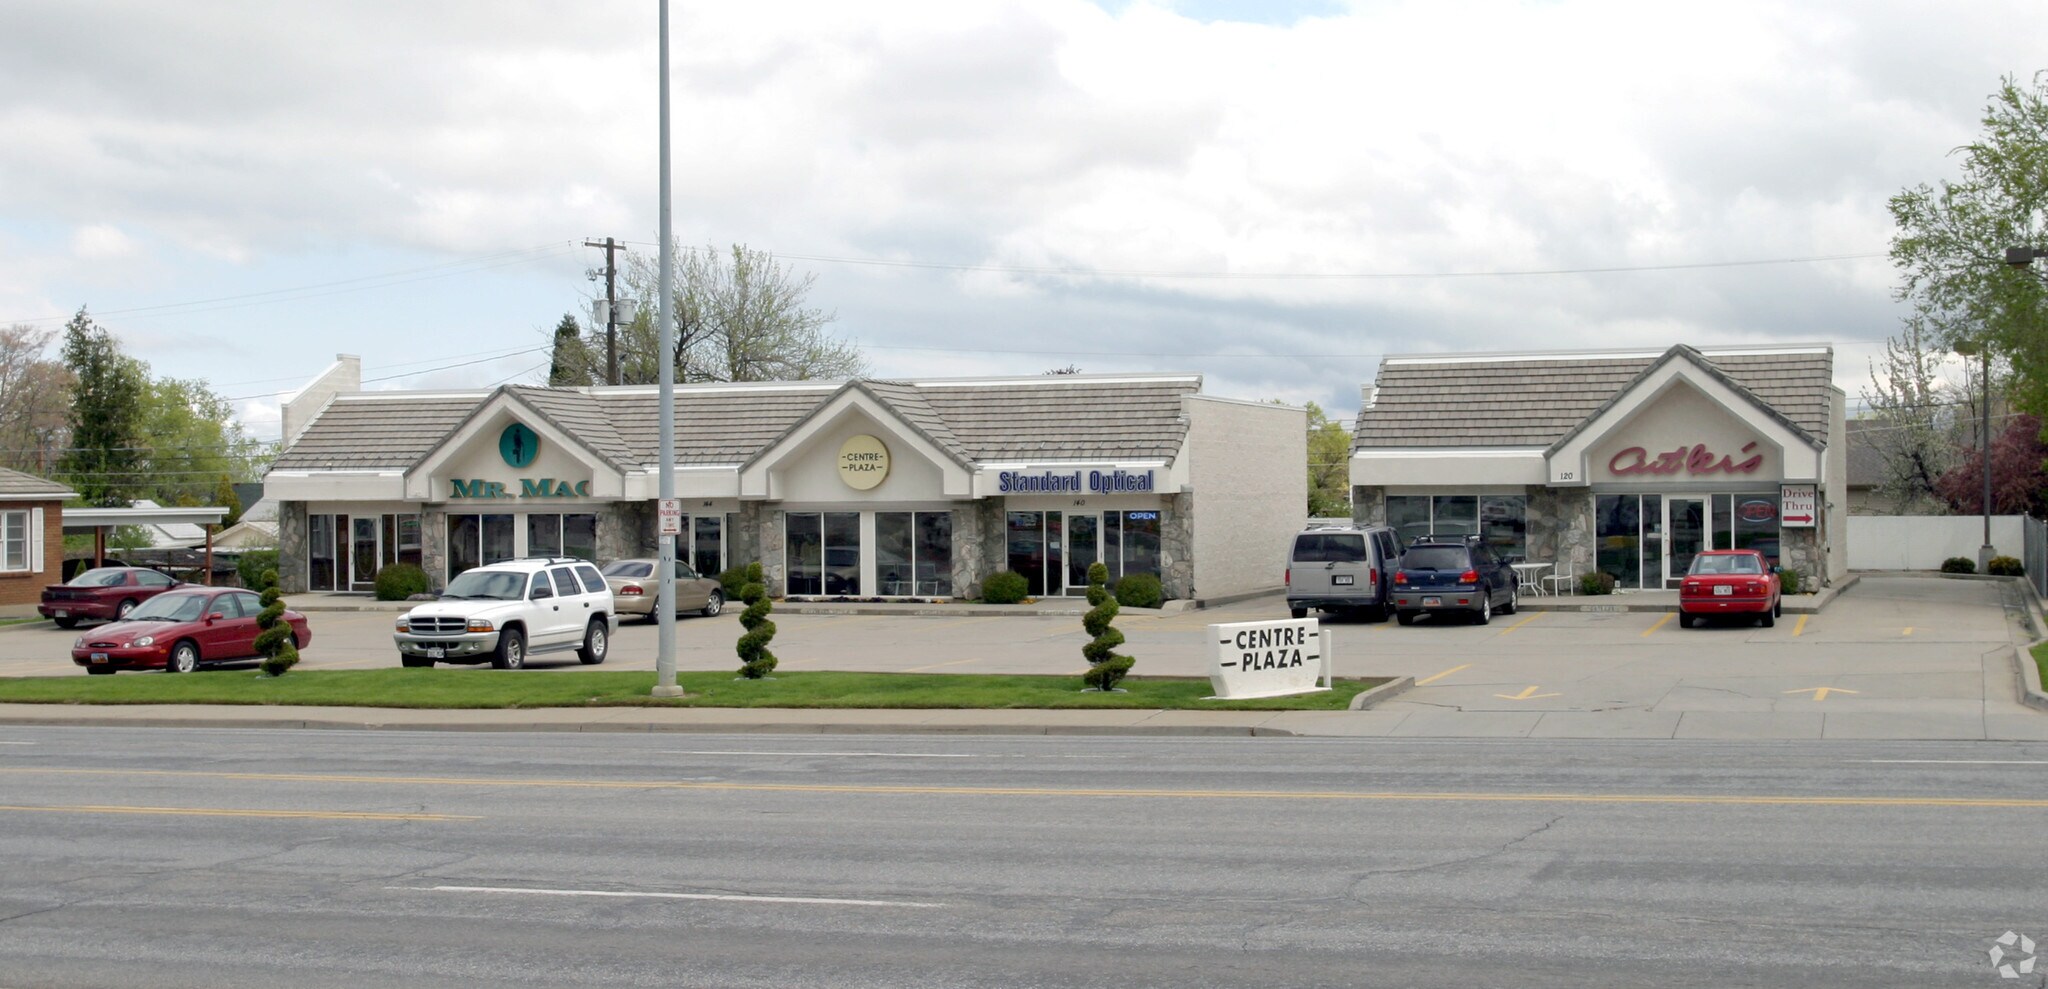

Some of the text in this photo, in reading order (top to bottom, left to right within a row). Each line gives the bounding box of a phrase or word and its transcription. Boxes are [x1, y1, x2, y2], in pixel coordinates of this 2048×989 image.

[846, 452, 879, 462] CENTRE
[848, 463, 876, 472] PLAZA
[1560, 472, 1574, 480] 120
[999, 470, 1155, 495] Standard Optical
[518, 478, 590, 498] MAC
[1783, 488, 1814, 498] Drive
[665, 501, 675, 509] NO
[1783, 501, 1813, 511] Thru
[660, 509, 680, 517] PARKING
[1130, 512, 1156, 520] OPEN
[1236, 626, 1305, 649] CENTRE
[1242, 649, 1302, 672] PLAZA
